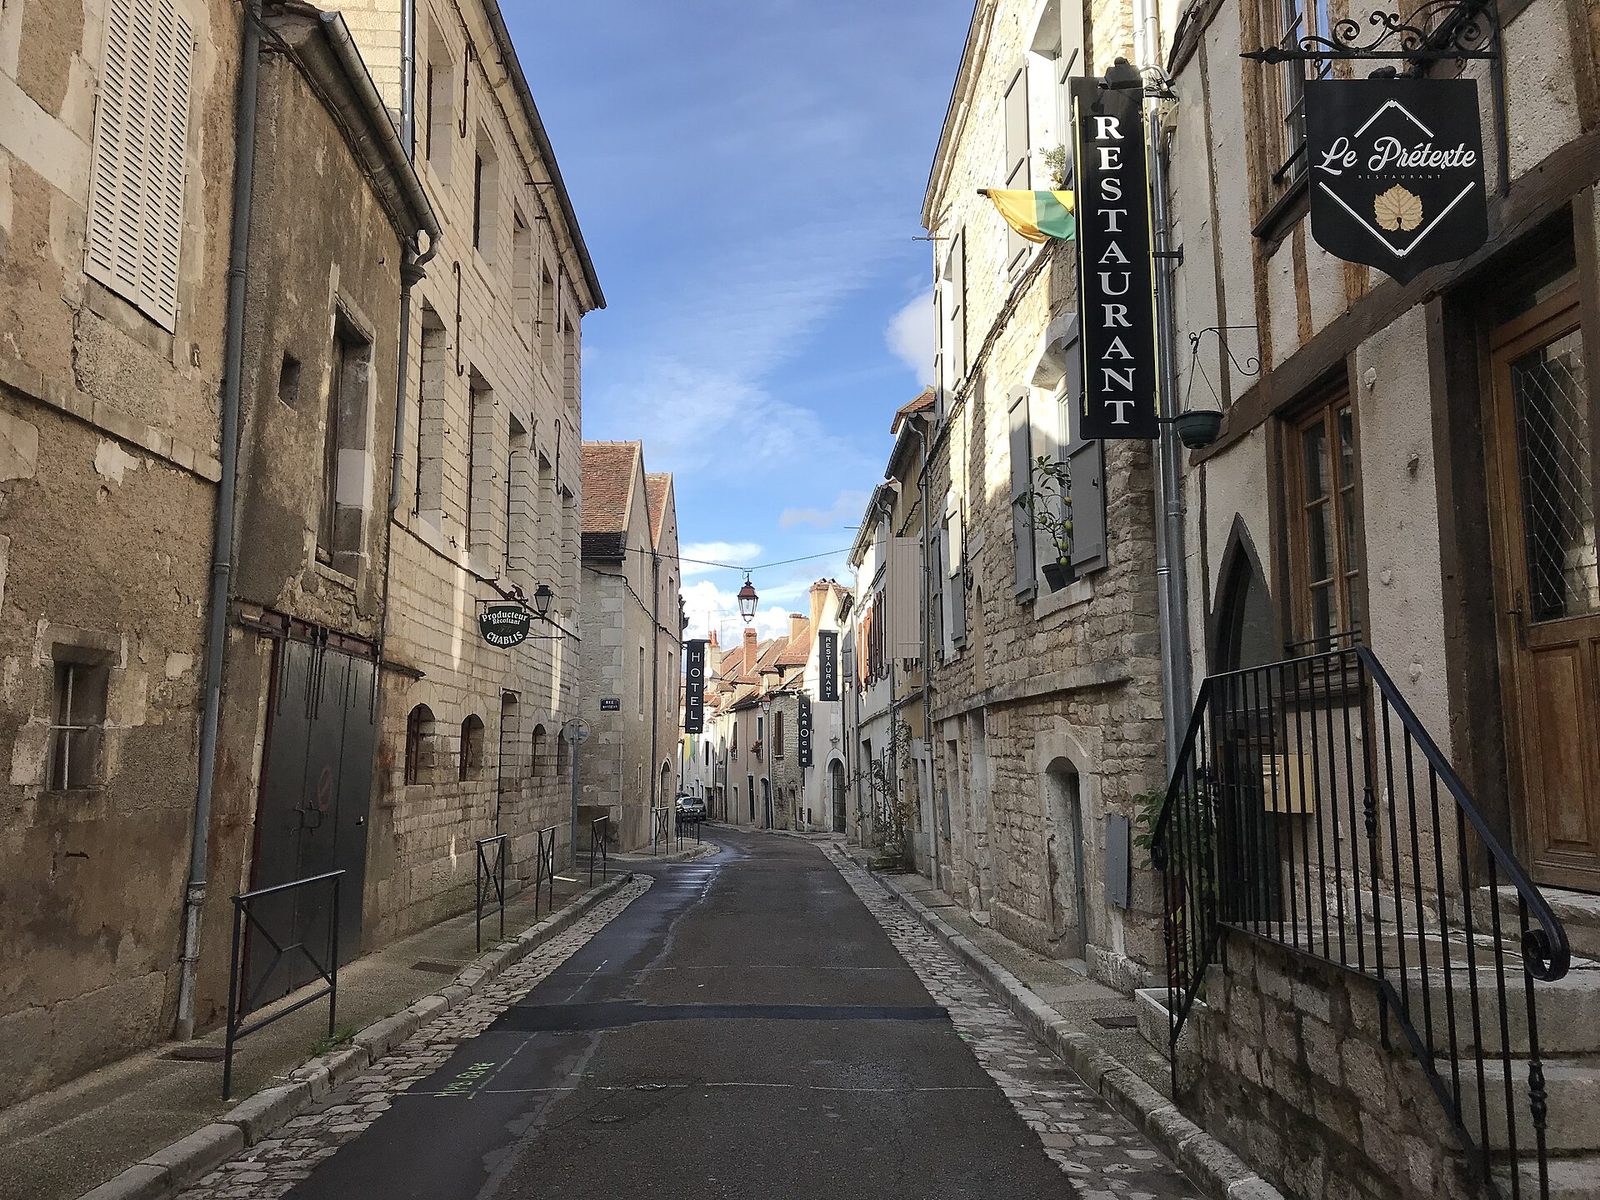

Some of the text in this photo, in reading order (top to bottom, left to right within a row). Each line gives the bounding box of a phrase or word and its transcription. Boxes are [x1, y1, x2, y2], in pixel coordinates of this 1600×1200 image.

[1313, 136, 1477, 176] Le Prétexte
[1093, 115, 1135, 425] RESTAURANT
[486, 631, 524, 645] CHABLIS
[690, 651, 701, 720] HOTEL
